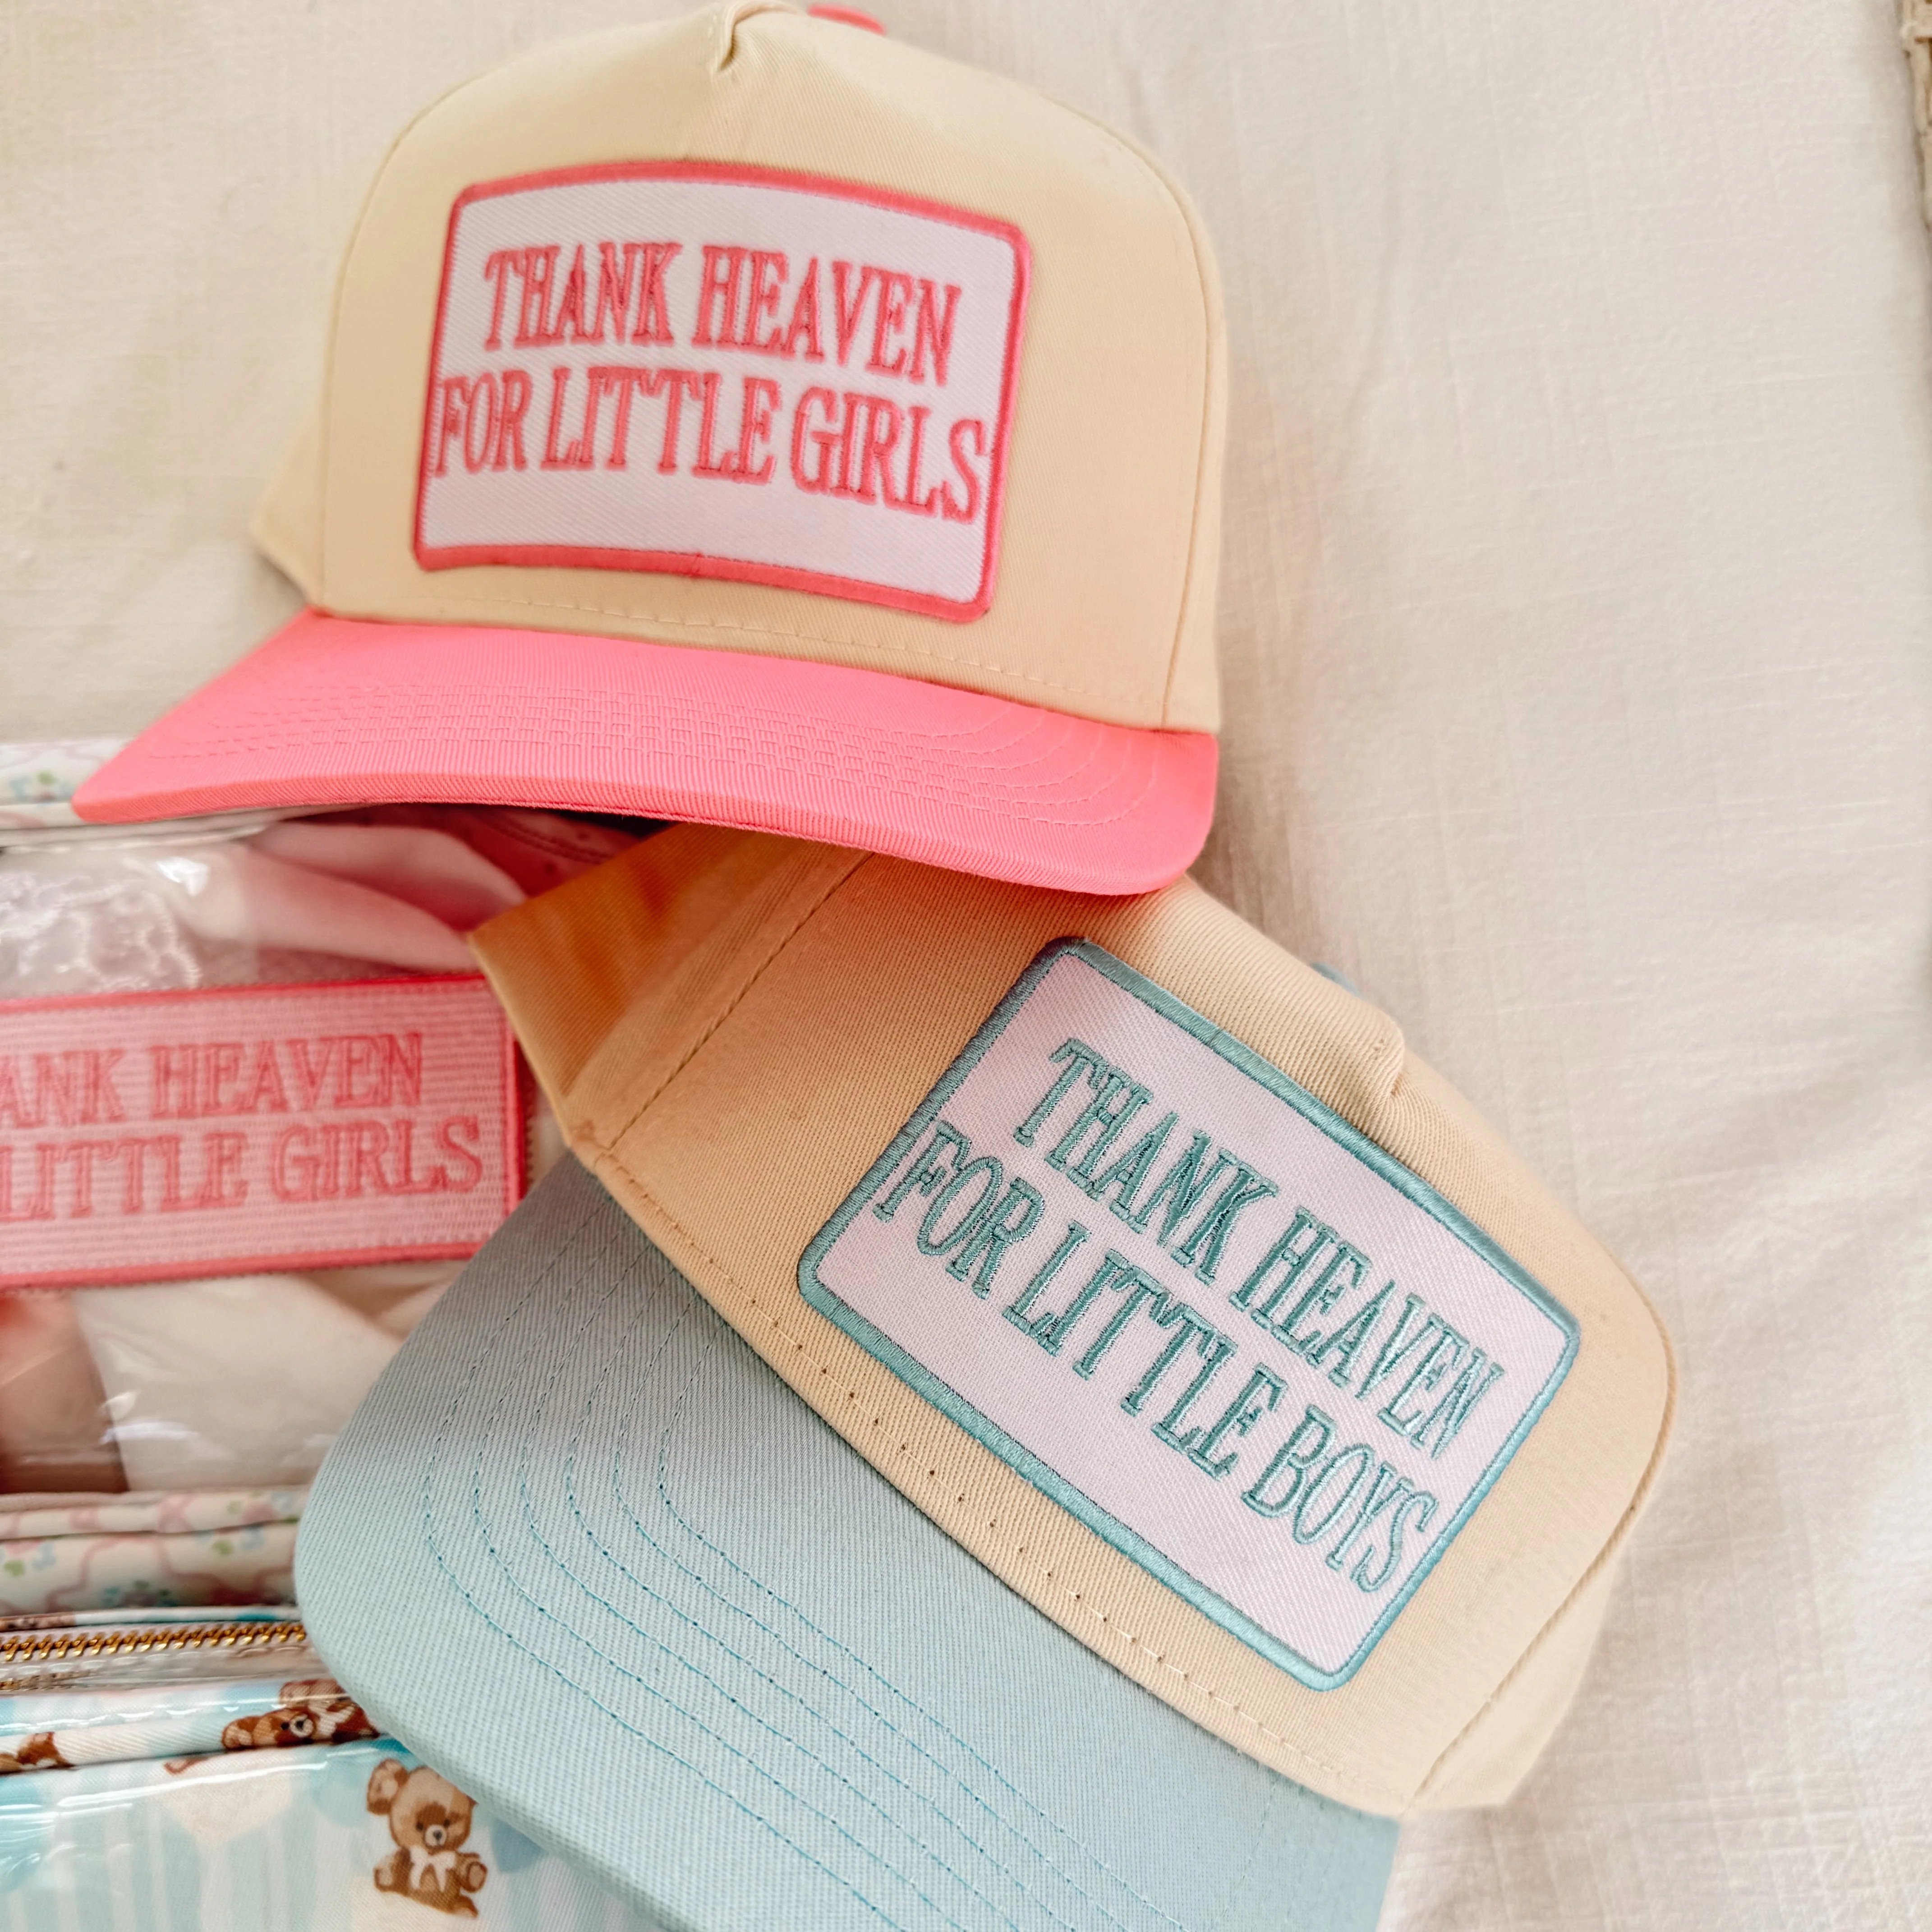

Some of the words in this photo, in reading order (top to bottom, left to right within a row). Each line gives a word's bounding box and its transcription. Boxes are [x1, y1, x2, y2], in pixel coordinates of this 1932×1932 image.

[483, 243, 682, 350] THANK
[691, 245, 961, 386] HEAVEN
[435, 370, 531, 477] FOR
[540, 367, 781, 483] LITTLE
[790, 388, 990, 524] GIRLS
[150, 1032, 423, 1118] HEAVEN
[0, 1134, 248, 1222] LITTLE
[271, 1116, 483, 1202] GIRLS
[1013, 1038, 1278, 1284] THANK
[1229, 1207, 1504, 1458] HEAVEN
[873, 1121, 1045, 1299] FOR
[1003, 1222, 1285, 1481] LITTLE
[1242, 1406, 1438, 1592] BOYS
